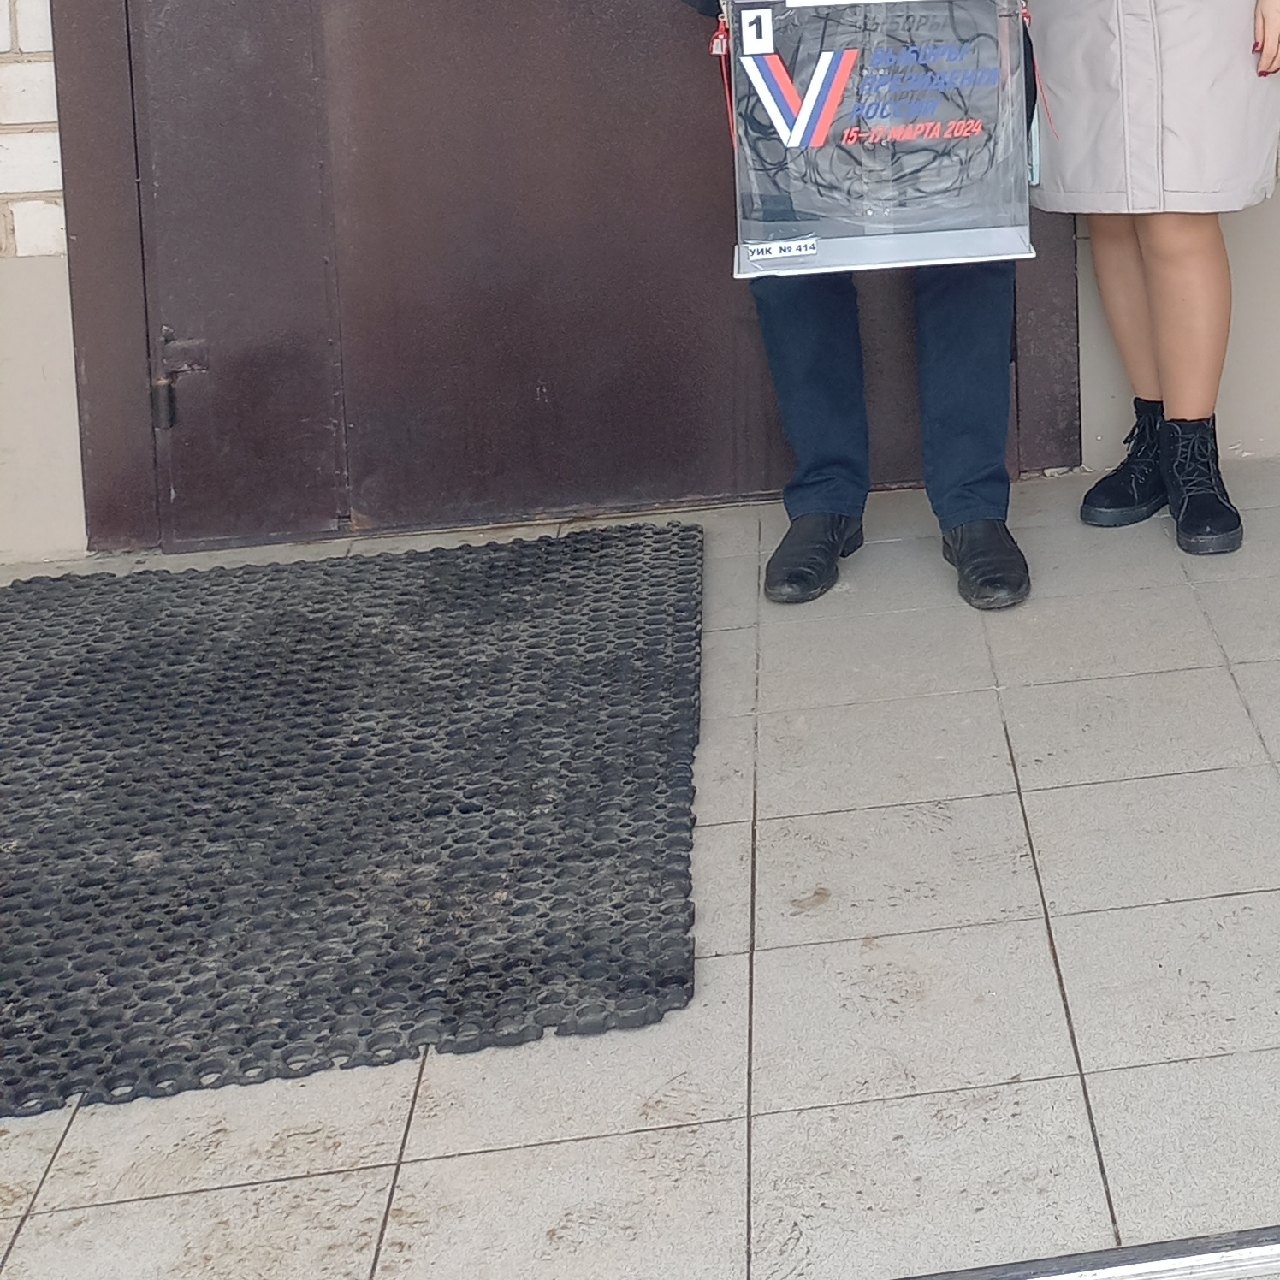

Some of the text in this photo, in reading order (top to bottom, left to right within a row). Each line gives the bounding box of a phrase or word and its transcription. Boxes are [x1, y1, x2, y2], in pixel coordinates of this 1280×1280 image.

[748, 14, 762, 40] 1
[887, 121, 942, 141] МАРТА
[944, 119, 984, 139] 2024
[749, 246, 773, 257] УИК
[796, 243, 816, 253] 414
